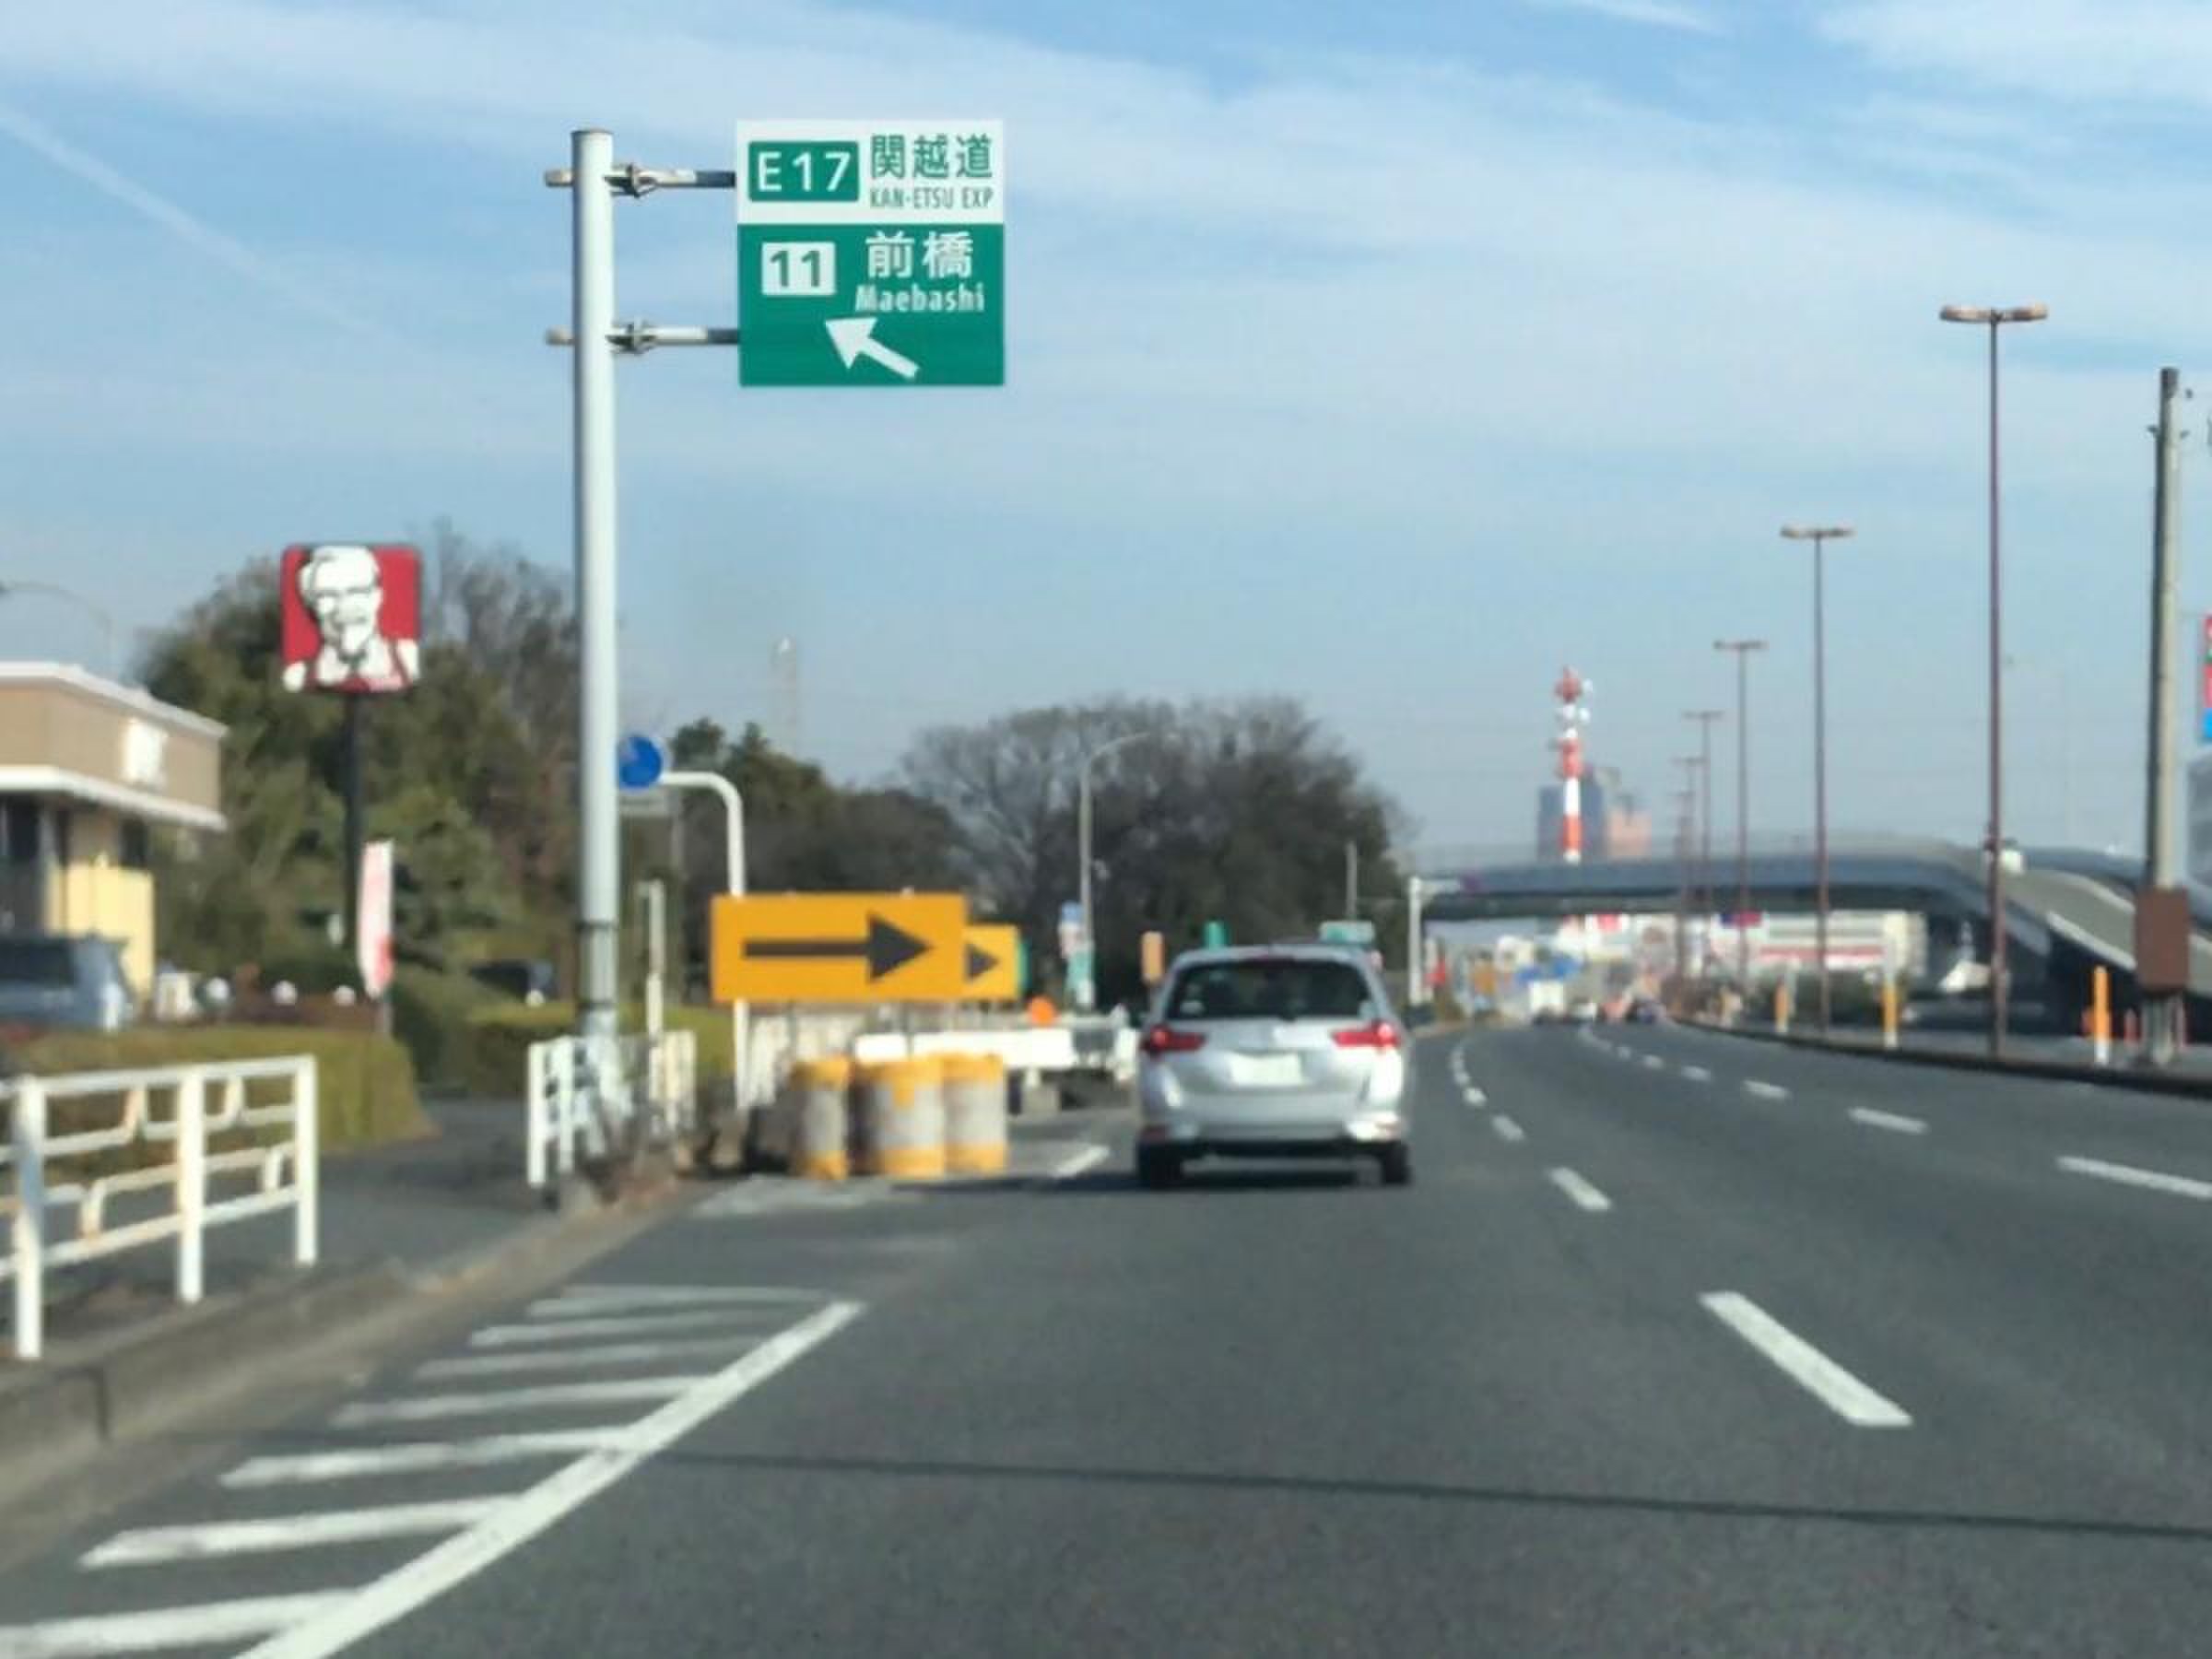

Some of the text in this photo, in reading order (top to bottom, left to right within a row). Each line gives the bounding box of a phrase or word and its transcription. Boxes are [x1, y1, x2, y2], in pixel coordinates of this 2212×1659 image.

[758, 151, 851, 192] E17
[870, 134, 993, 179] 関越道
[870, 187, 994, 208] KAN-ETSU EXP
[770, 250, 820, 288] 11
[865, 230, 973, 279] 前橋
[854, 282, 985, 312] Maebashi
